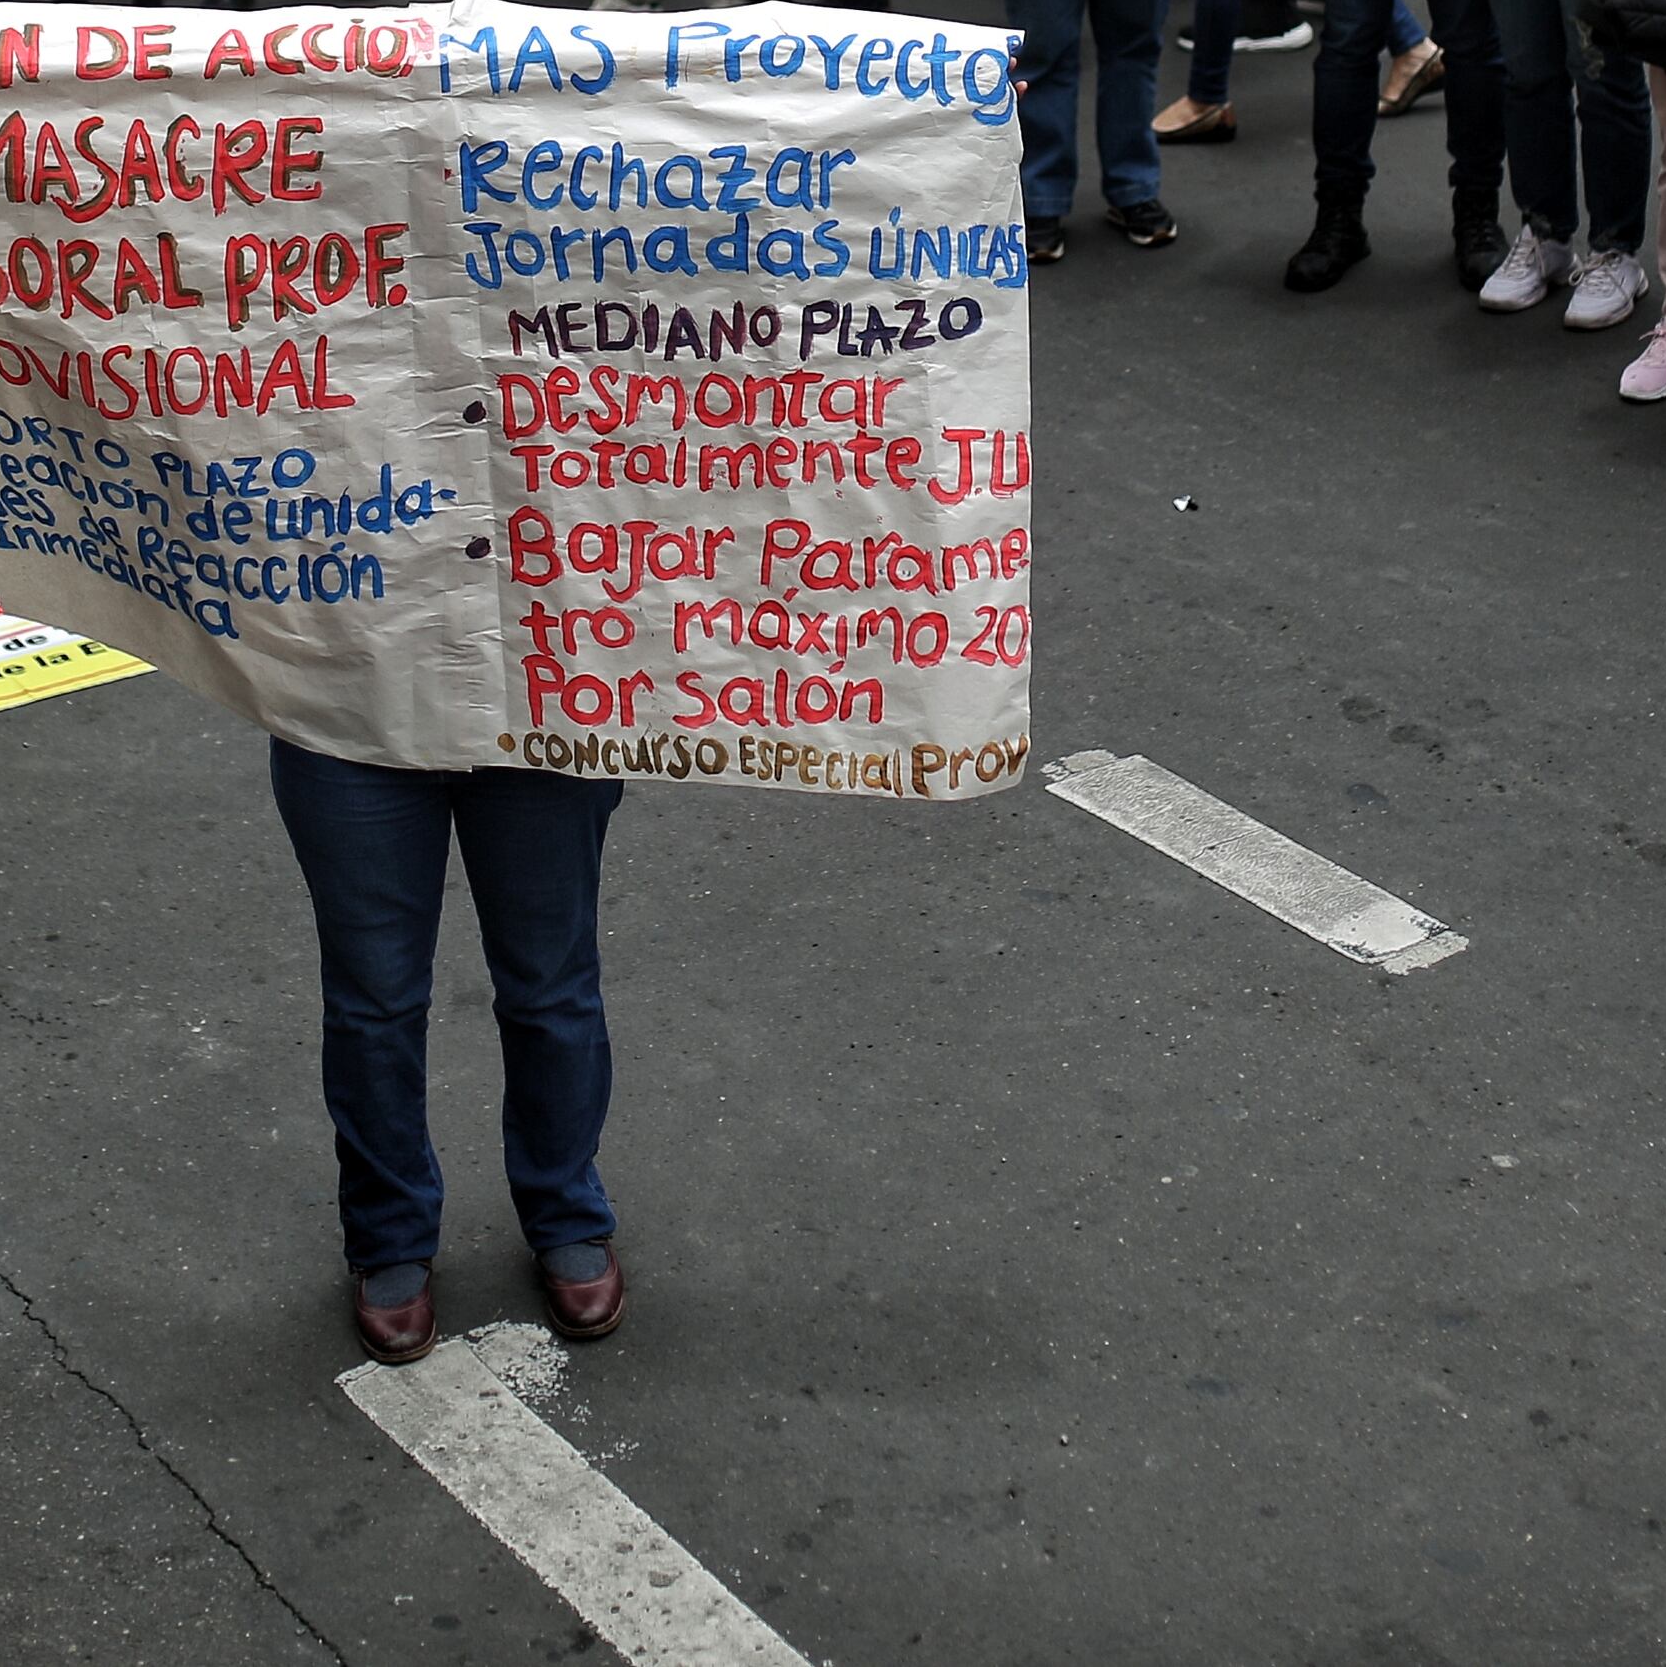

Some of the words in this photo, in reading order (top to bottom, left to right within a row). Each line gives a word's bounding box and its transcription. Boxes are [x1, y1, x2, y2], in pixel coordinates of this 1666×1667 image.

[76, 24, 176, 82] DE
[438, 24, 618, 96] MAS
[459, 139, 857, 213] Rechazar
[223, 222, 409, 331] PROF.
[464, 211, 851, 290] Jornadas
[869, 205, 1029, 289] ÚNICAS
[508, 300, 783, 362] MEDIANO
[801, 296, 984, 360] PLAZO
[496, 365, 907, 442] Desmontar
[150, 448, 316, 498] PLAZO
[509, 430, 921, 492] Totalmente
[78, 505, 121, 546] de
[136, 526, 385, 604] Reacción
[188, 495, 254, 543] de
[508, 505, 736, 602] Bajar
[4, 632, 49, 652] de
[32, 648, 70, 668] la
[519, 600, 636, 656] tro
[672, 586, 950, 669] máximo
[960, 604, 1029, 669] 20
[522, 653, 654, 730] Por
